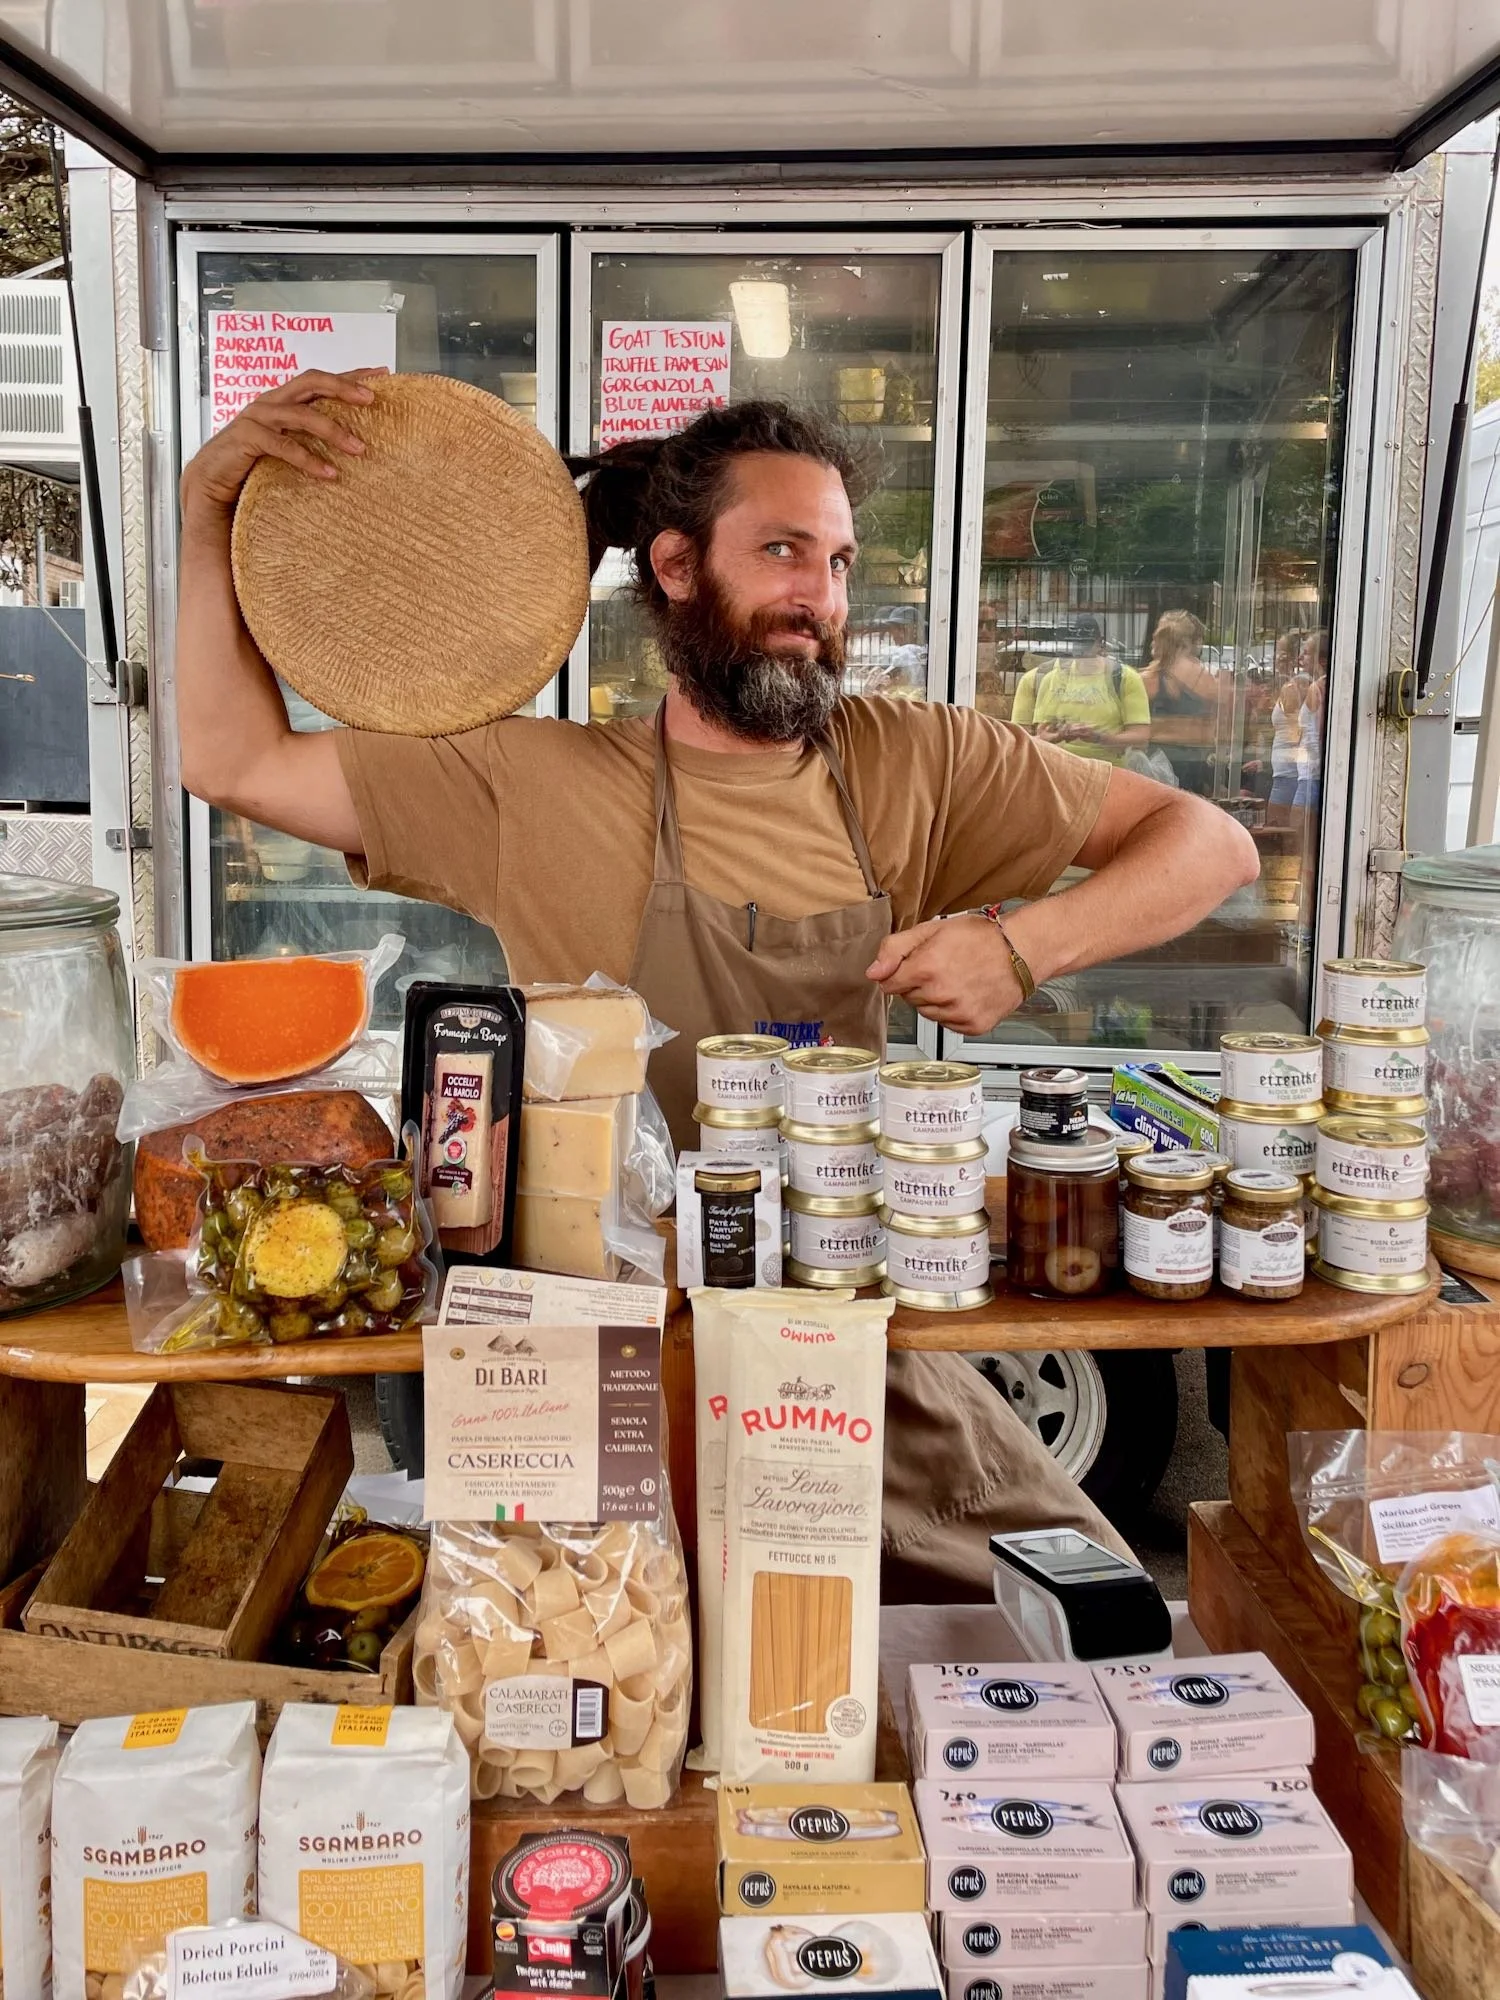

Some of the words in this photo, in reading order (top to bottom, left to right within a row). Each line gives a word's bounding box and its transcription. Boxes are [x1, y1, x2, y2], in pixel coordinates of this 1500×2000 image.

[217, 315, 264, 331] FRESH
[216, 336, 284, 353] BURRATA
[609, 328, 656, 350] GOAT
[660, 329, 725, 349] TESTUN
[215, 354, 298, 370] BURRATINA
[603, 356, 660, 372] TRUFFLE
[664, 353, 728, 372] PARMESAN
[603, 377, 714, 393] GORGONZOLA
[605, 396, 648, 413] BLUE
[434, 1023, 471, 1043] Formaggi
[480, 1027, 507, 1046] Borgo
[444, 1087, 452, 1096] AL
[453, 1088, 479, 1098] BAROLO
[1135, 1115, 1158, 1144] cling
[1200, 1128, 1213, 1145] 600
[781, 1328, 836, 1344] RUMMO
[475, 1368, 493, 1385] DI
[502, 1368, 548, 1385] BARI
[610, 1370, 650, 1379] METODO
[602, 1382, 658, 1392] TRADIZIONALE
[611, 1417, 647, 1426] SEMOLA
[741, 1405, 872, 1443] RUMMO
[614, 1430, 644, 1439] EXTRA
[605, 1443, 653, 1453] CALIBRATA
[448, 1453, 575, 1469] CASERECCIA
[780, 1469, 844, 1495] Lenta
[769, 1551, 812, 1564] FETTUCCE
[933, 1665, 979, 1677] 7.50
[1104, 1665, 1151, 1677] 7.50
[490, 1688, 568, 1700] CALAMARATI
[989, 1689, 1029, 1703] PEPUS
[1179, 1683, 1220, 1699] PEPUS
[496, 1703, 560, 1714] CASERECCI
[131, 1728, 175, 1737] ITALIANO
[949, 1748, 973, 1762] PEPUS
[1153, 1747, 1176, 1762] PEPUS
[785, 1761, 801, 1770] 500
[799, 1818, 840, 1834] PEPUS
[1001, 1811, 1043, 1827] PEPUS
[1208, 1812, 1253, 1829] PEPUS
[299, 1830, 422, 1851] SGAMBARO
[83, 1839, 206, 1866] SGAMBARO
[744, 1882, 770, 1897] PEPUS
[954, 1876, 980, 1891] PEPUS
[1173, 1878, 1200, 1893] PEPUS
[969, 1932, 995, 1947] PEPUS
[182, 1942, 223, 1961] Dried
[229, 1935, 285, 1957] Porcini
[807, 1951, 851, 1969] PEPUS
[182, 1964, 232, 1986] Boletus
[237, 1960, 278, 1978] Edulis
